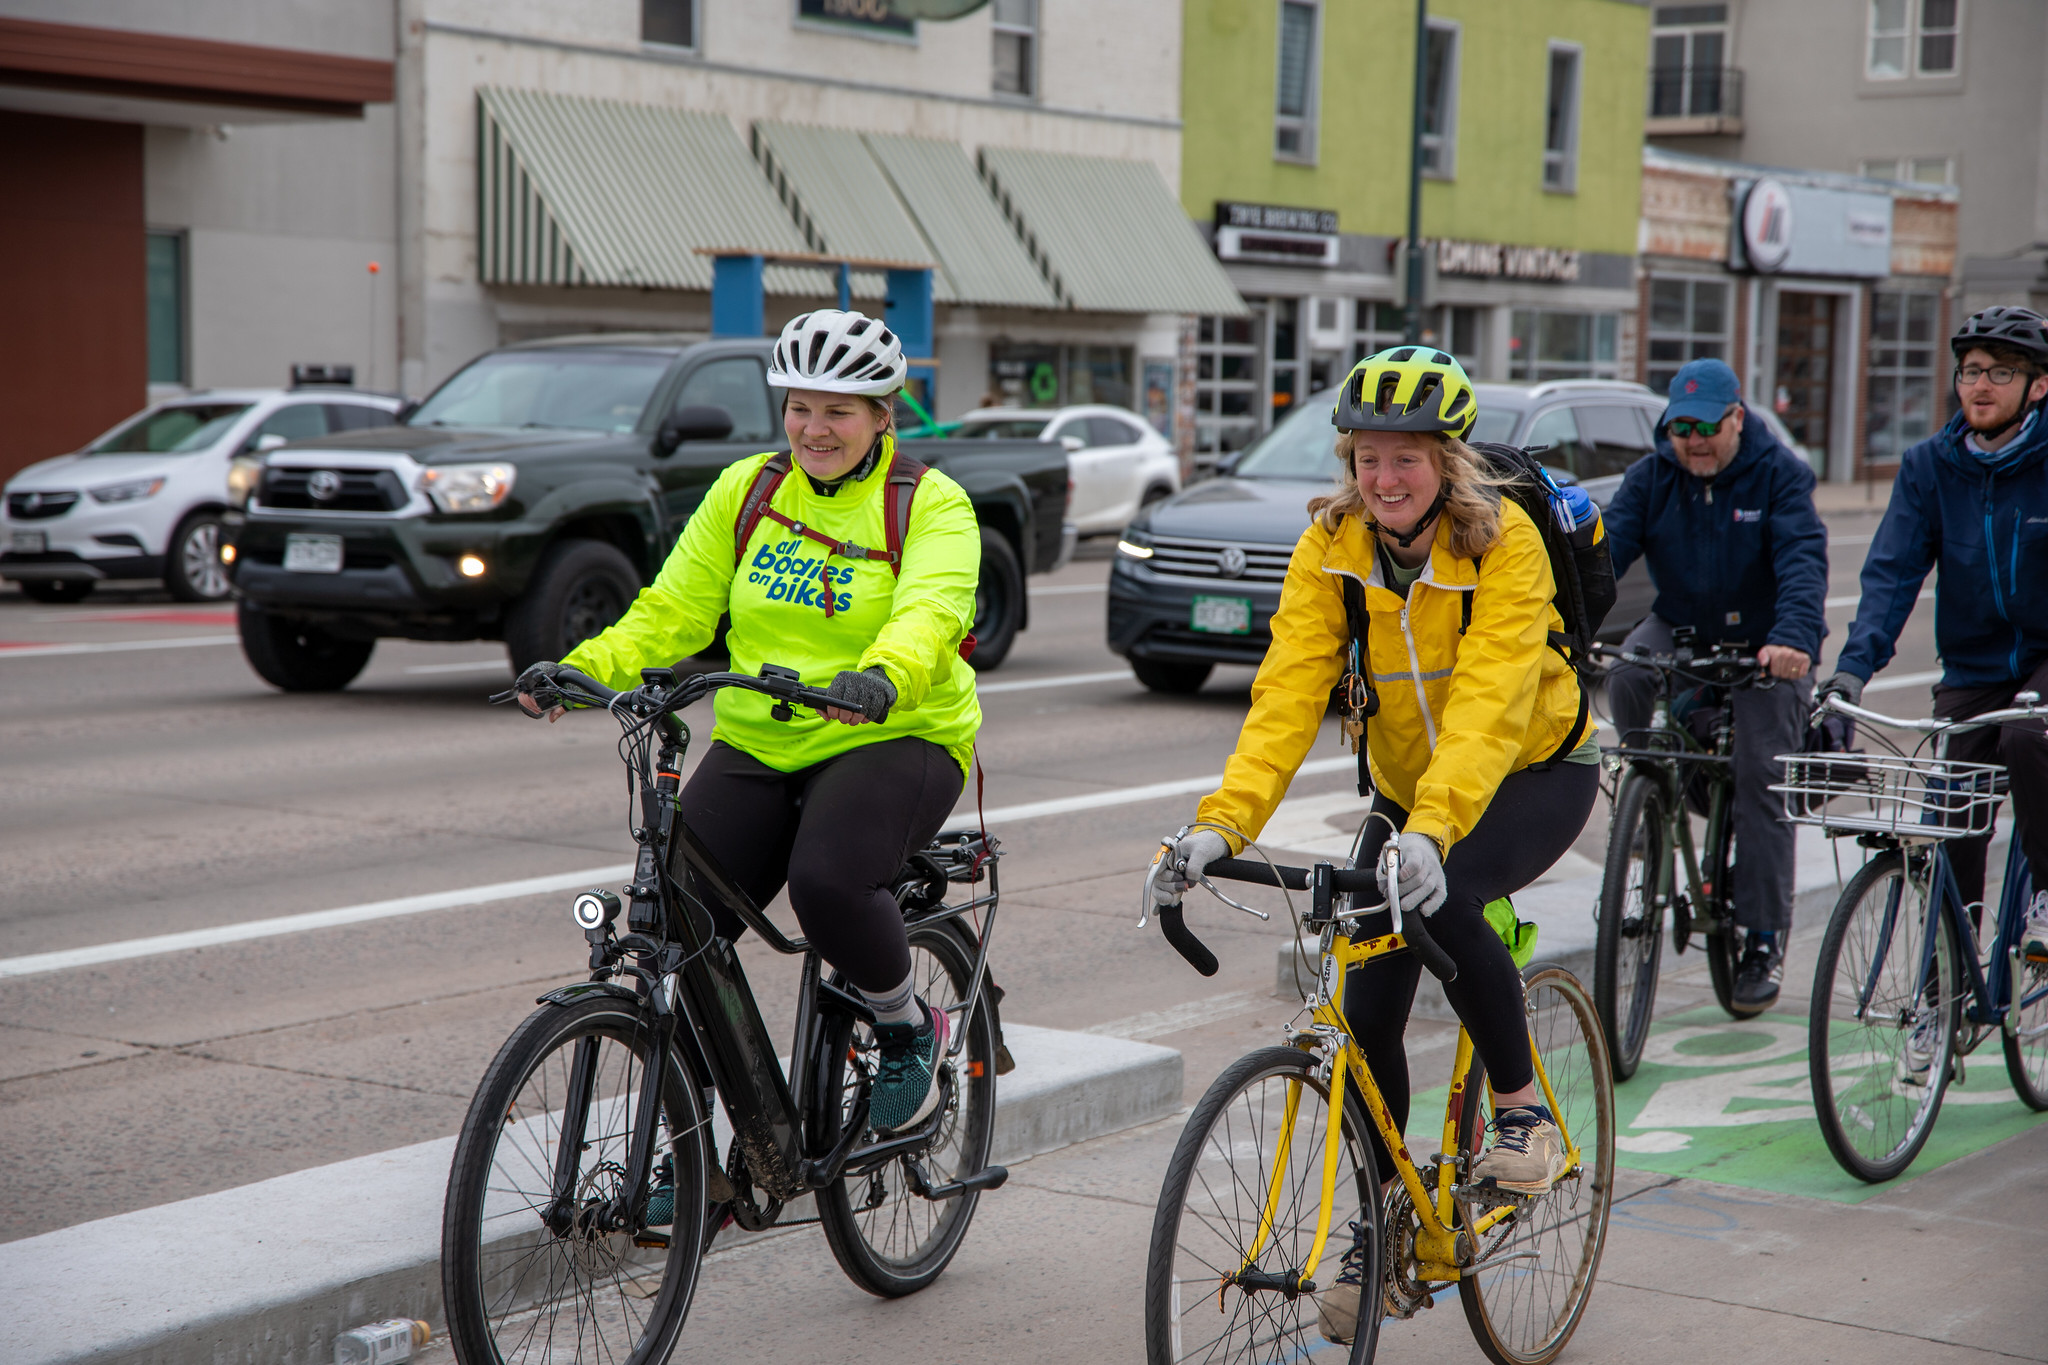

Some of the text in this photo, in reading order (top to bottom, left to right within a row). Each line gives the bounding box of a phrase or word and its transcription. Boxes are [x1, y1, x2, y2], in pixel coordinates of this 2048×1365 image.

[1503, 246, 1578, 285] VINTAGE
[752, 543, 855, 585] bodies
[775, 540, 803, 556] all
[748, 572, 853, 612] on bikes
